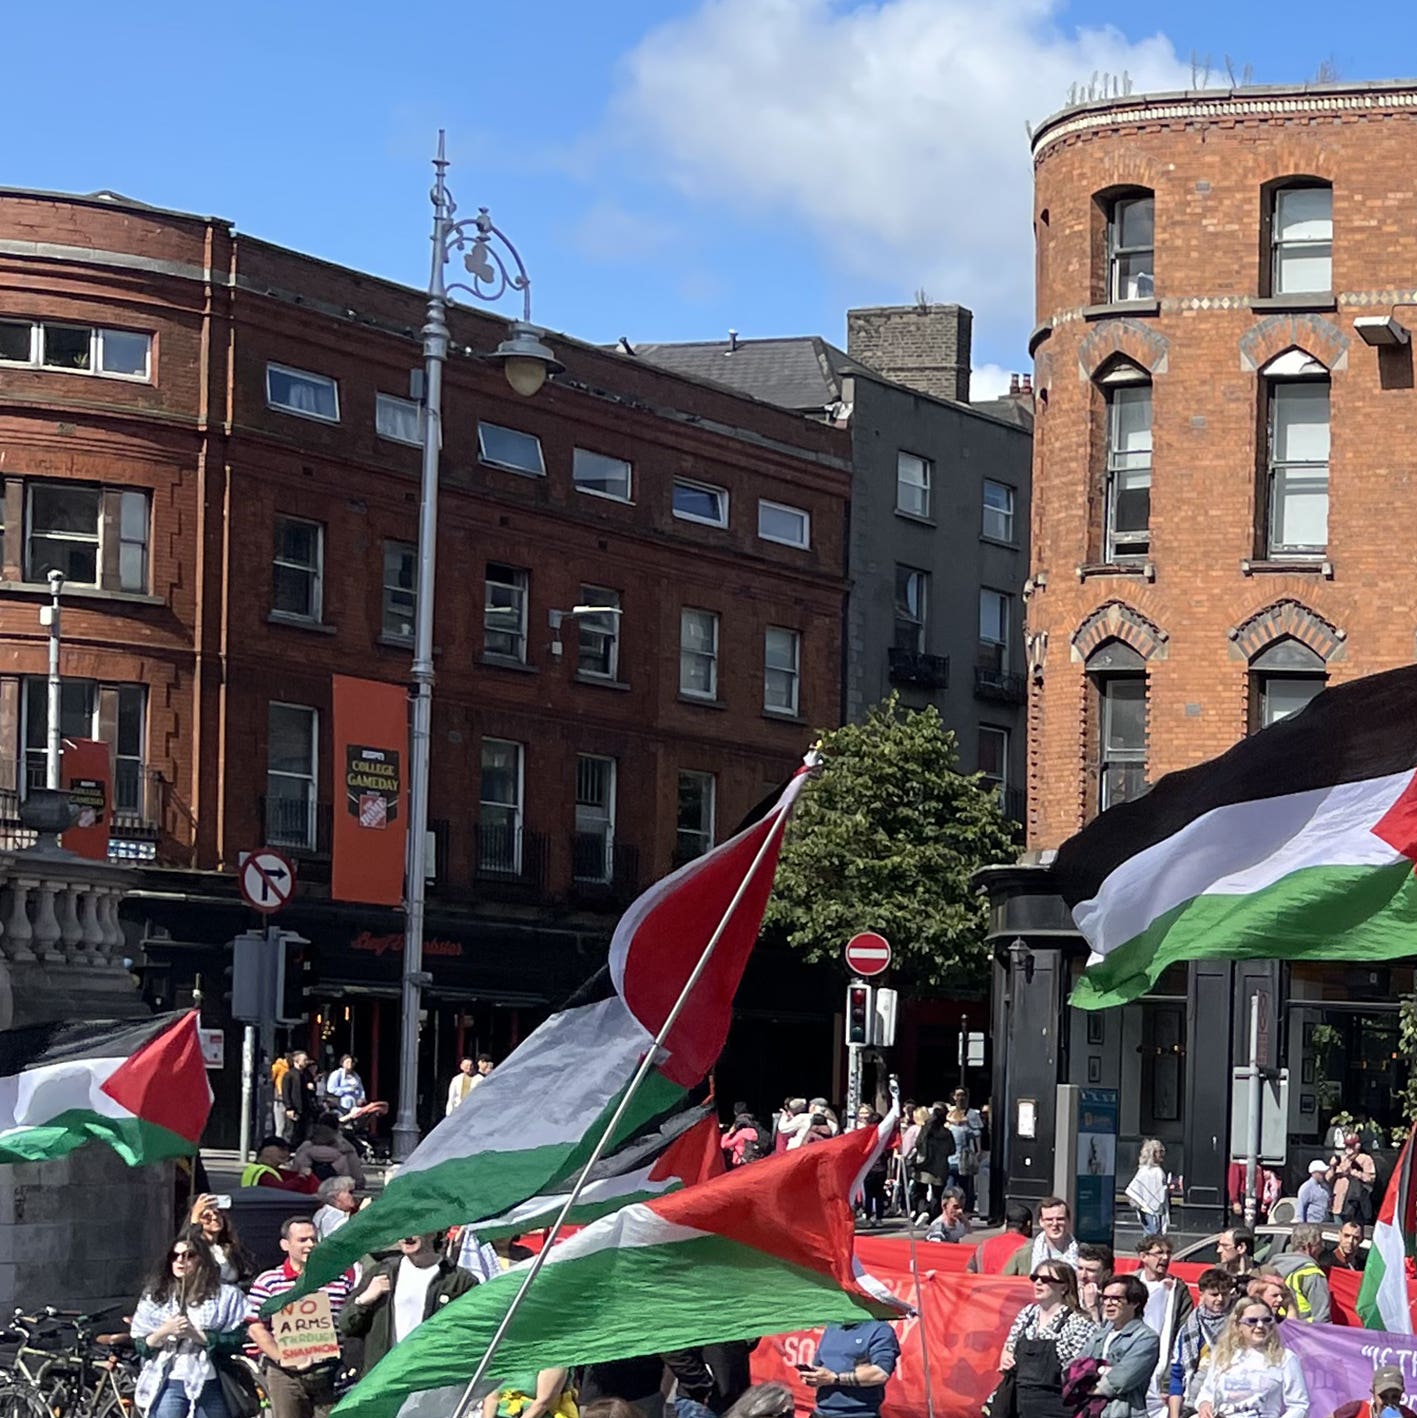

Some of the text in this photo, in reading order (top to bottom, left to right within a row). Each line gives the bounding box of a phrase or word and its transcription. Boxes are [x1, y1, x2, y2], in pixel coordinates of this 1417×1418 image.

[352, 760, 395, 776] COLLEGE
[347, 773, 399, 791] GAMEDAY
[281, 1300, 317, 1316] NO
[280, 1317, 331, 1333] ARMS
